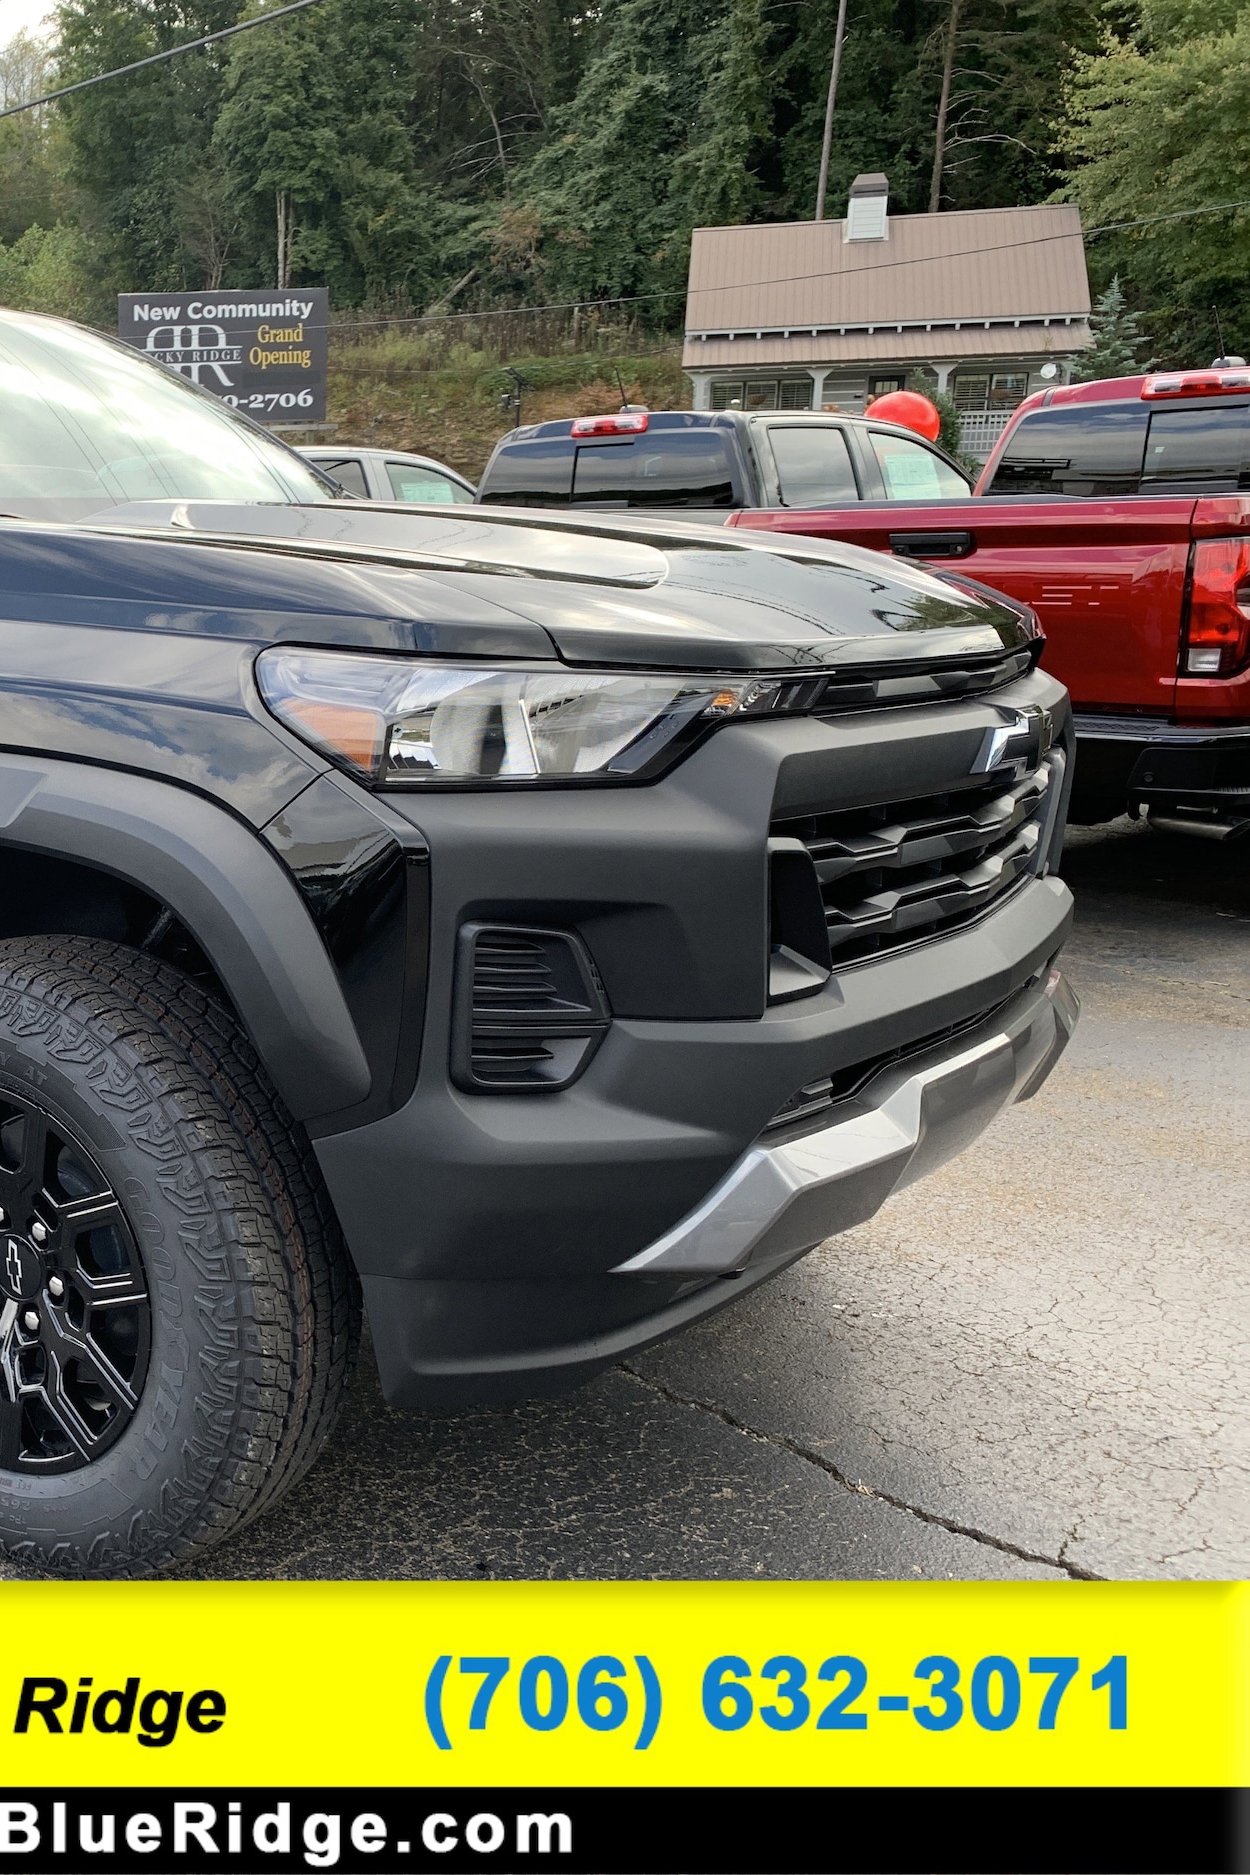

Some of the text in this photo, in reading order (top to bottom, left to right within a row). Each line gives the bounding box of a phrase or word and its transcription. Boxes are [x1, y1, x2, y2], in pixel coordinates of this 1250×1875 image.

[133, 298, 313, 322] New Community
[257, 323, 304, 343] Grand
[152, 349, 242, 363] CKY RIDGE
[249, 346, 312, 369] Opening
[23, 1065, 48, 1086] AT
[123, 1177, 190, 1481] GOODYEAR
